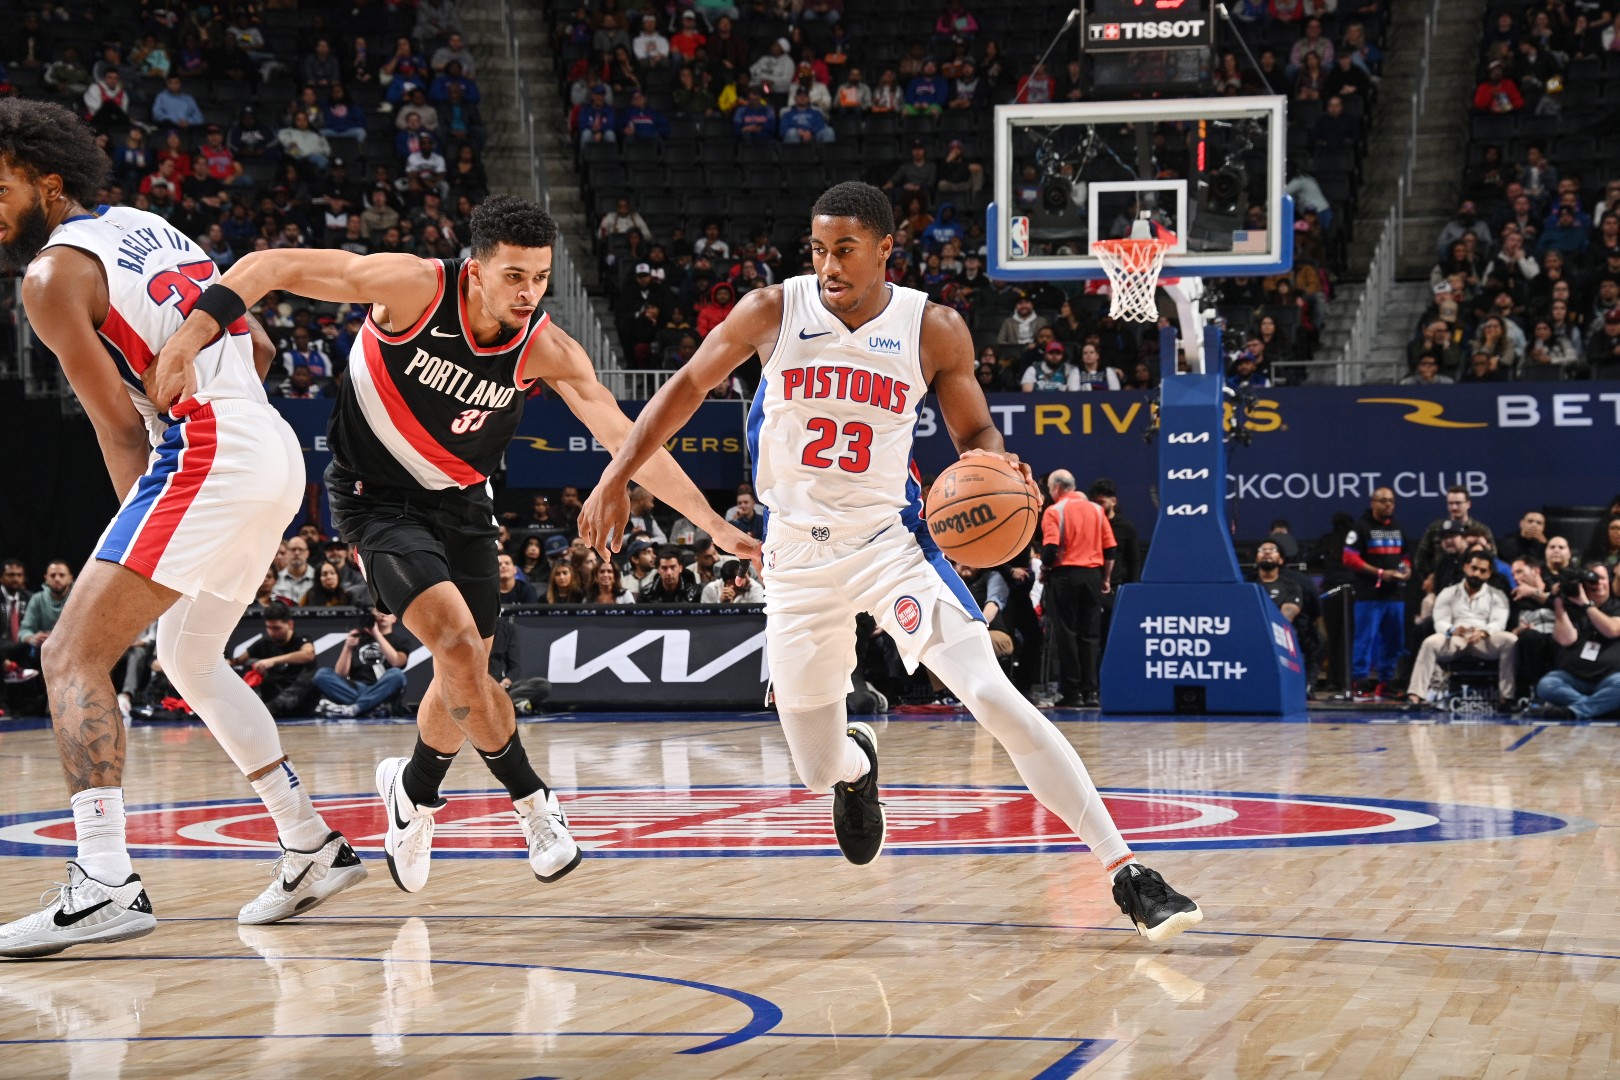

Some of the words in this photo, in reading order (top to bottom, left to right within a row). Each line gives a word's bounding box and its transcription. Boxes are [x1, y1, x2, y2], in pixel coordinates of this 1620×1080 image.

[1120, 20, 1206, 39] TISSOT
[117, 227, 163, 275] BAGLEY
[869, 336, 901, 351] UWM
[403, 347, 516, 409] PORTLAND
[781, 366, 910, 414] PISTONS
[801, 417, 873, 473] 23
[1393, 471, 1489, 498] CLUB
[930, 503, 998, 535] Wilson
[1139, 616, 1231, 635] HENRY
[1145, 638, 1211, 657] FORD
[1145, 660, 1248, 680] HEALTH
